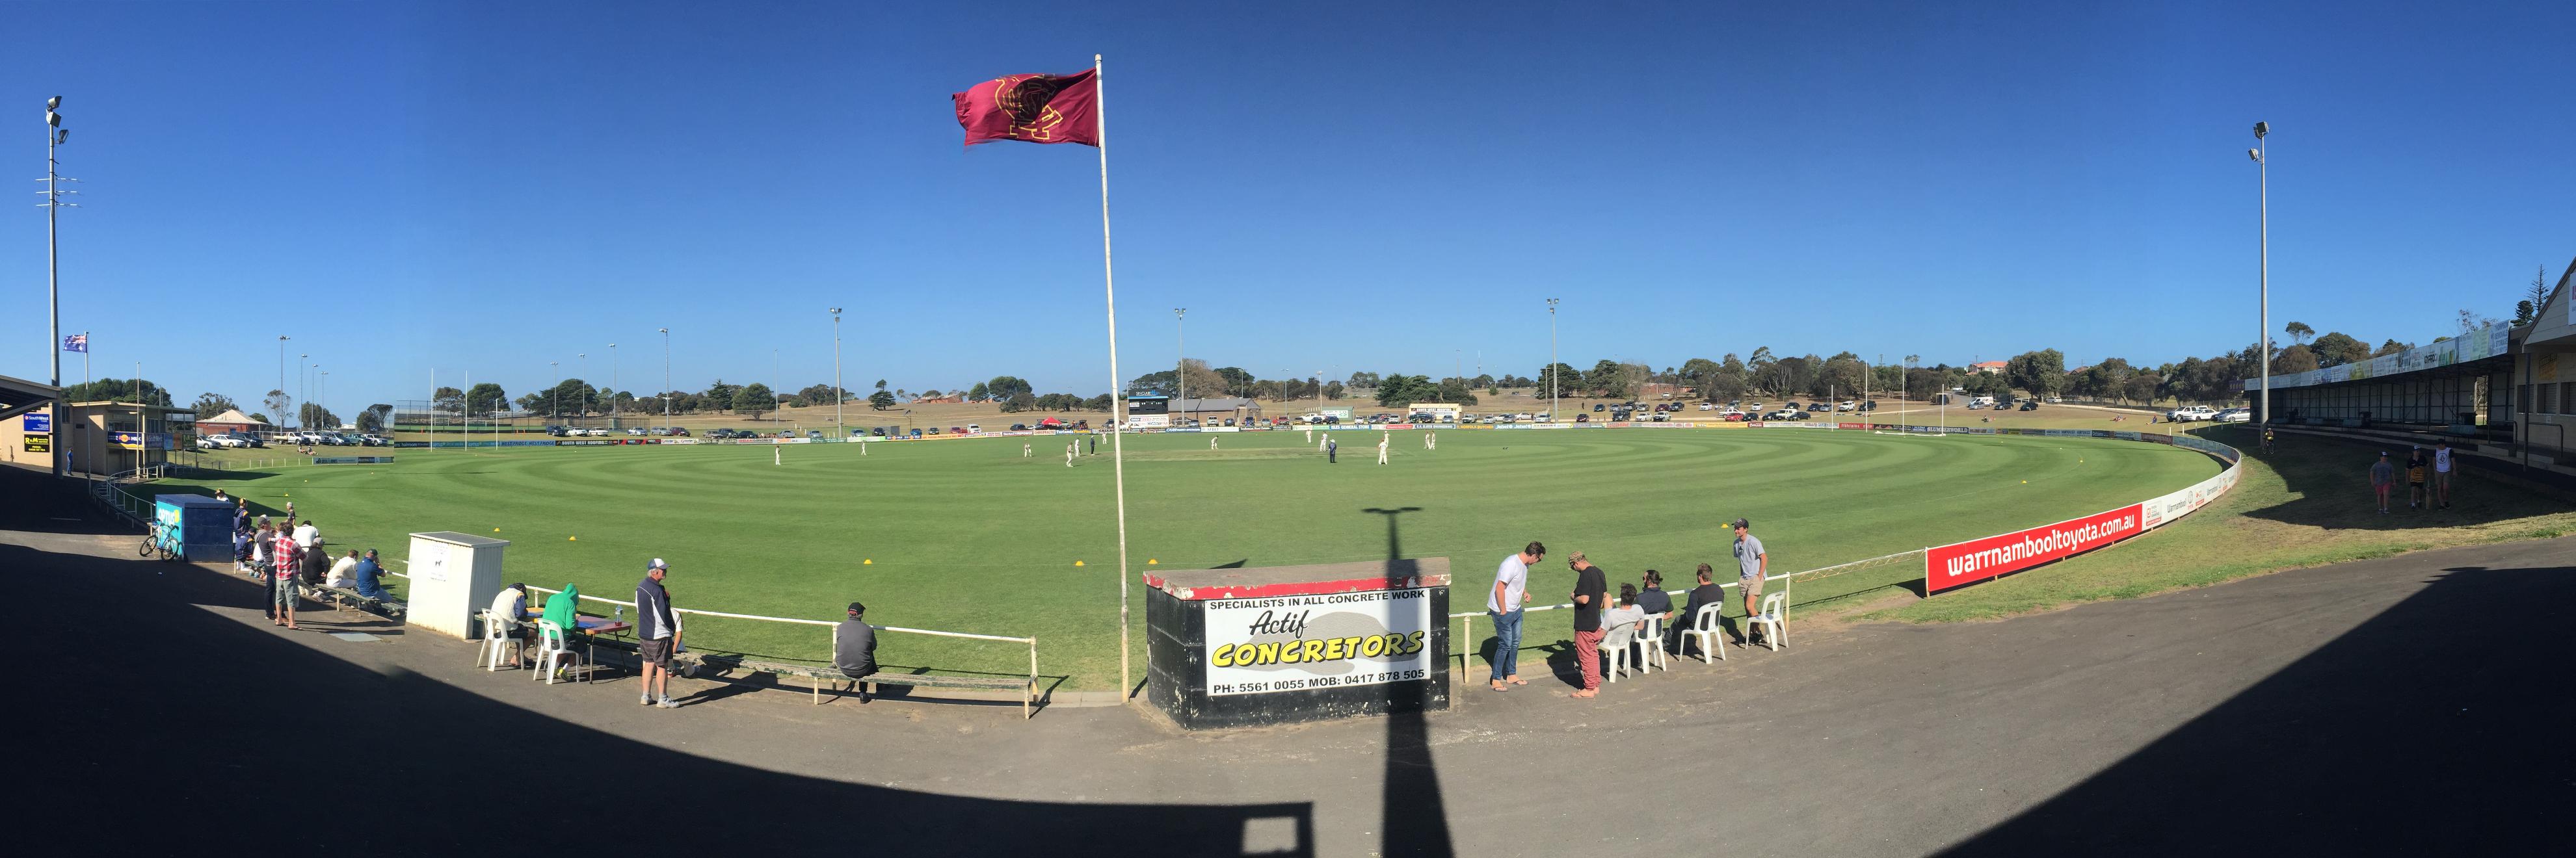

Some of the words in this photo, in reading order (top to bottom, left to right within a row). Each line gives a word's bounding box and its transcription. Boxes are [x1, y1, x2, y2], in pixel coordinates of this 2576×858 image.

[1947, 514, 2135, 576] warrnambooltoyota.com.au
[1210, 599, 1284, 610] SPECIALISTS
[1304, 596, 1324, 604] ALL
[1329, 592, 1388, 603] CONCRETE
[1392, 590, 1425, 600] WORK
[1249, 610, 1310, 638] Actif
[1212, 630, 1425, 667] CONCRETORS
[1214, 684, 1235, 694] PH:
[1239, 682, 1269, 692] 5561
[1274, 680, 1305, 690] 0055
[1308, 677, 1341, 688] MOB:
[1345, 673, 1374, 685] 0417
[1378, 671, 1400, 682] 878
[1403, 669, 1425, 679] 505
